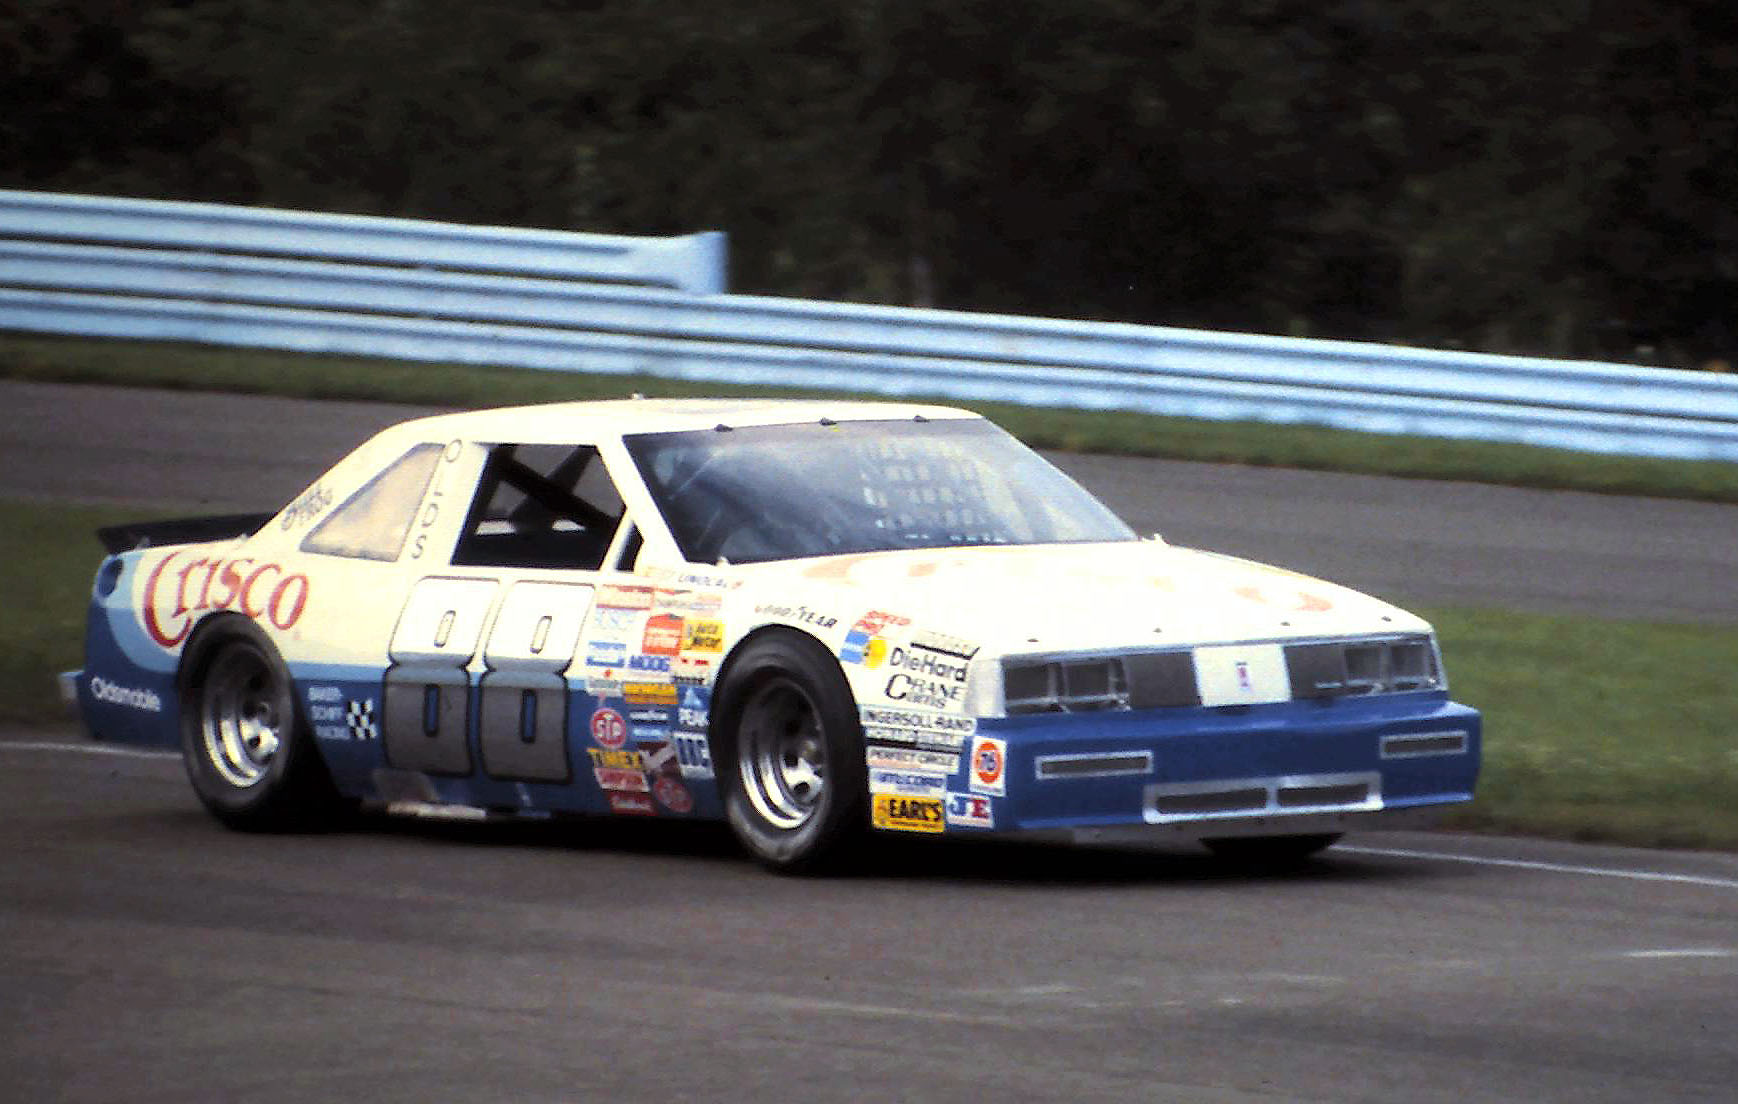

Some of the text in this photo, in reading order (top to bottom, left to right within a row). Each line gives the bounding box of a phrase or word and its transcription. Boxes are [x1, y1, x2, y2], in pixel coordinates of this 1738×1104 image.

[145, 549, 309, 649] Crisco
[888, 646, 970, 682] DieHard
[90, 677, 161, 713] Oldsmobile
